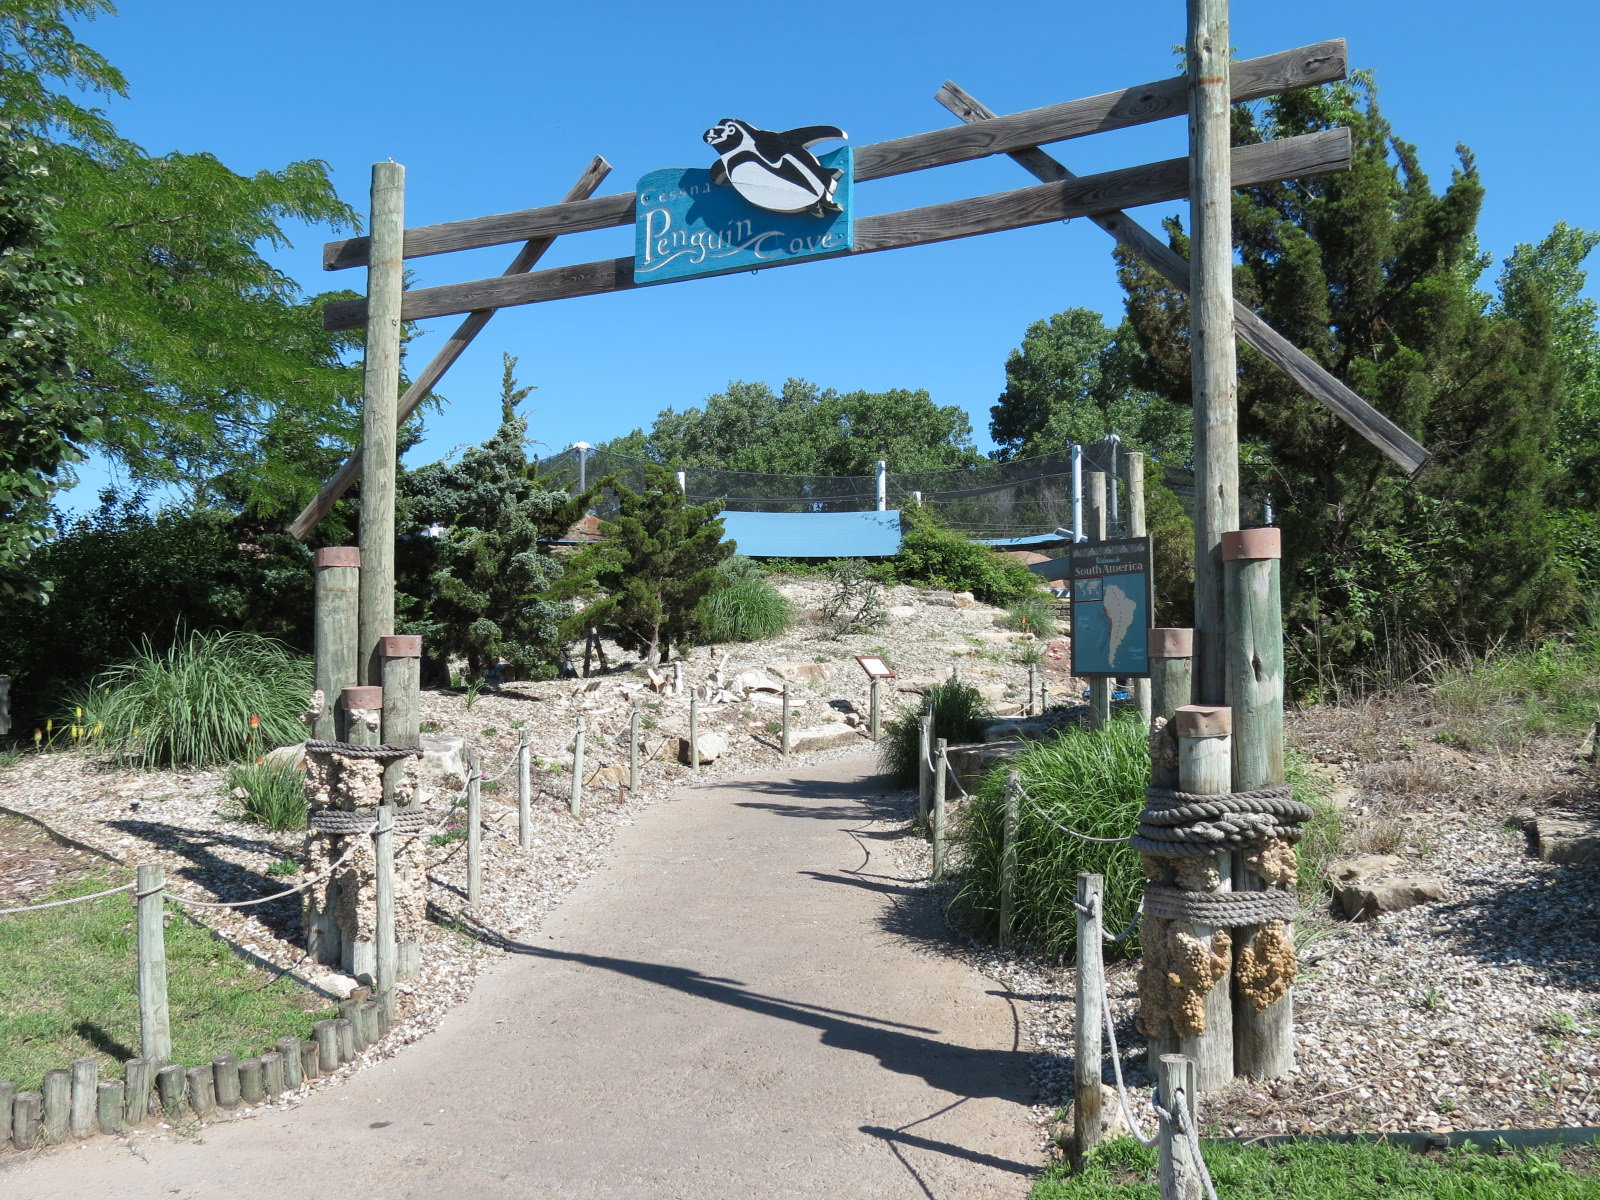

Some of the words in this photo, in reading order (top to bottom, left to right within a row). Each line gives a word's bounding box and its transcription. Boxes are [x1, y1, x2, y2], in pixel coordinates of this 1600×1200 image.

[640, 182, 711, 206] Cessna
[640, 207, 753, 265] Penguin
[754, 231, 842, 259] Cove
[1074, 565, 1102, 576] South
[1103, 562, 1143, 574] America
